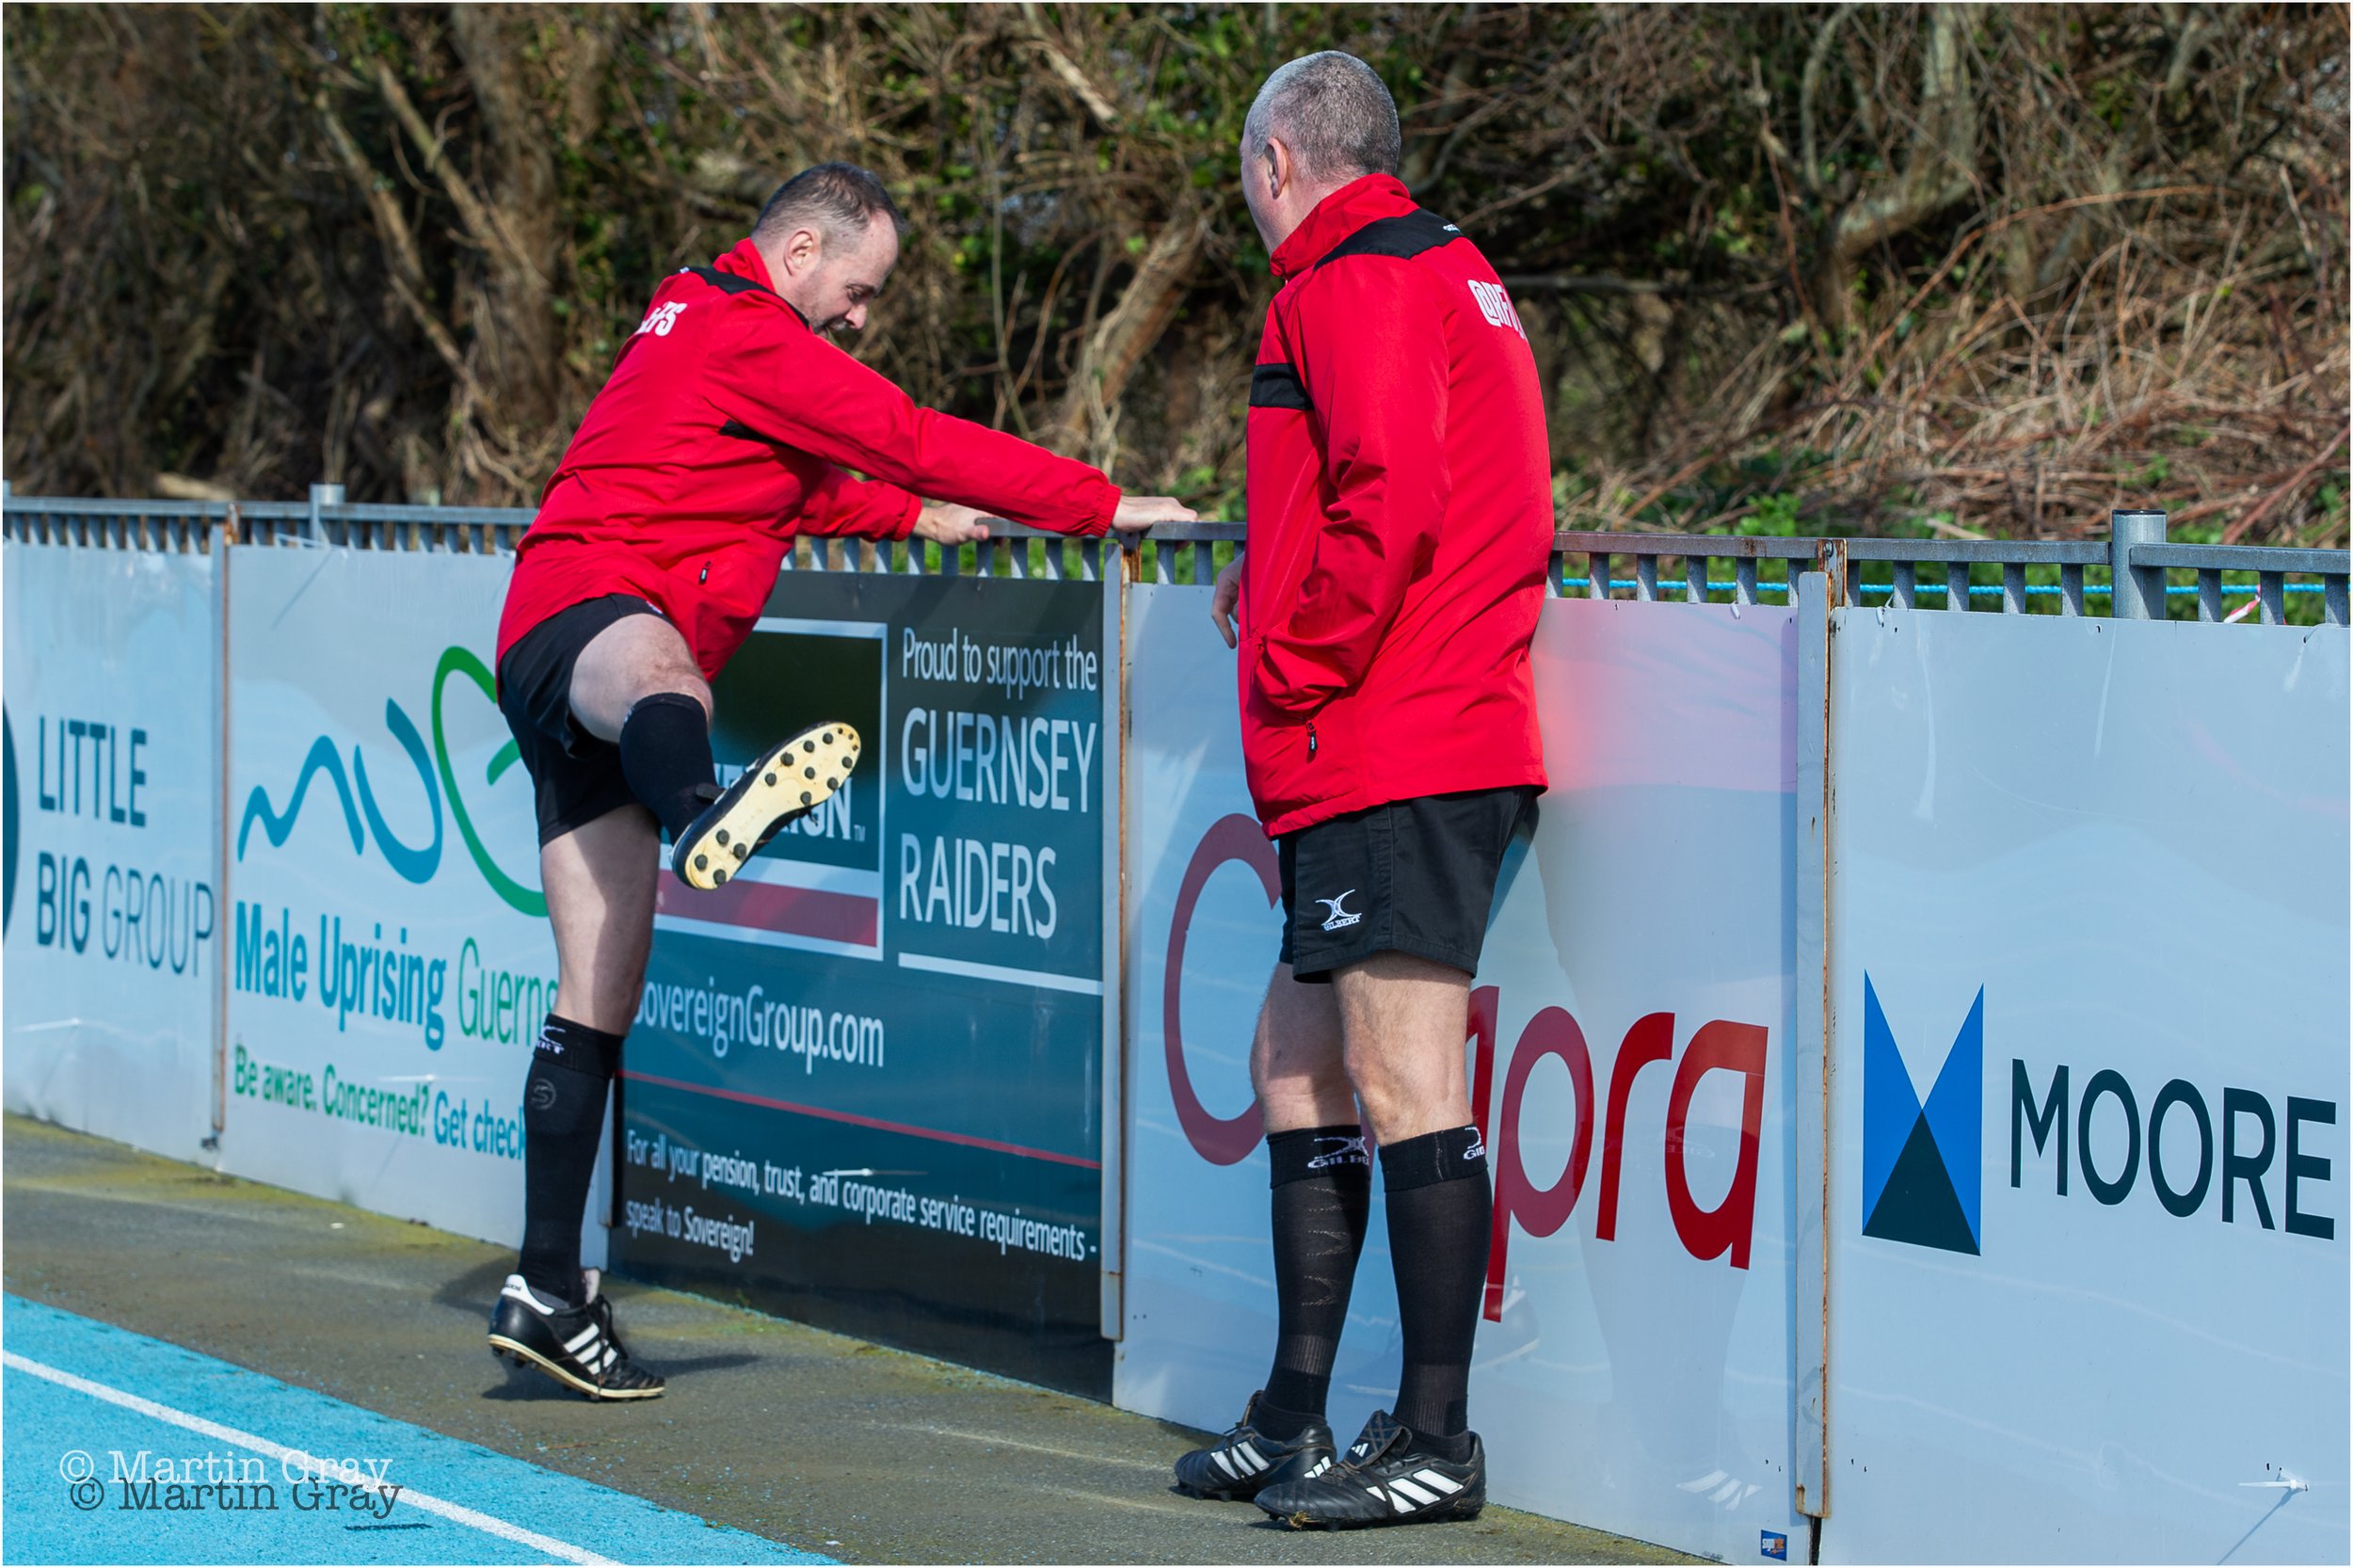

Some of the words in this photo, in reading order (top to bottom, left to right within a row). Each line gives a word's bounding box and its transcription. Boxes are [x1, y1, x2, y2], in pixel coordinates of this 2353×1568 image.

[903, 627, 957, 682] Proud
[963, 641, 980, 683] to
[986, 640, 1061, 700] support
[1064, 633, 1096, 691] the
[38, 715, 147, 828] LITTLE
[901, 706, 1096, 813] GUERNSEY
[37, 851, 91, 957] BIG
[102, 864, 215, 977] GROUP
[899, 832, 1057, 939] RAIDERS
[235, 901, 308, 1002] Male
[319, 913, 447, 1051] Uprising
[235, 1044, 257, 1097] Be
[263, 1064, 317, 1112] aware.
[323, 1063, 429, 1137] Concerned?
[433, 1090, 468, 1149] Get
[2010, 1058, 2337, 1241] MOORE
[625, 1199, 665, 1239] speak
[667, 1208, 680, 1240] to
[682, 1207, 755, 1264] Sovereign!
[627, 1128, 647, 1165] For
[651, 1134, 666, 1171] all
[668, 1145, 698, 1182] your
[701, 1149, 760, 1196] pension,
[764, 1159, 805, 1206] trust,
[809, 1167, 839, 1208] and
[842, 1181, 917, 1224] corporate
[920, 1195, 974, 1237] service
[980, 1209, 1085, 1262] requirements
